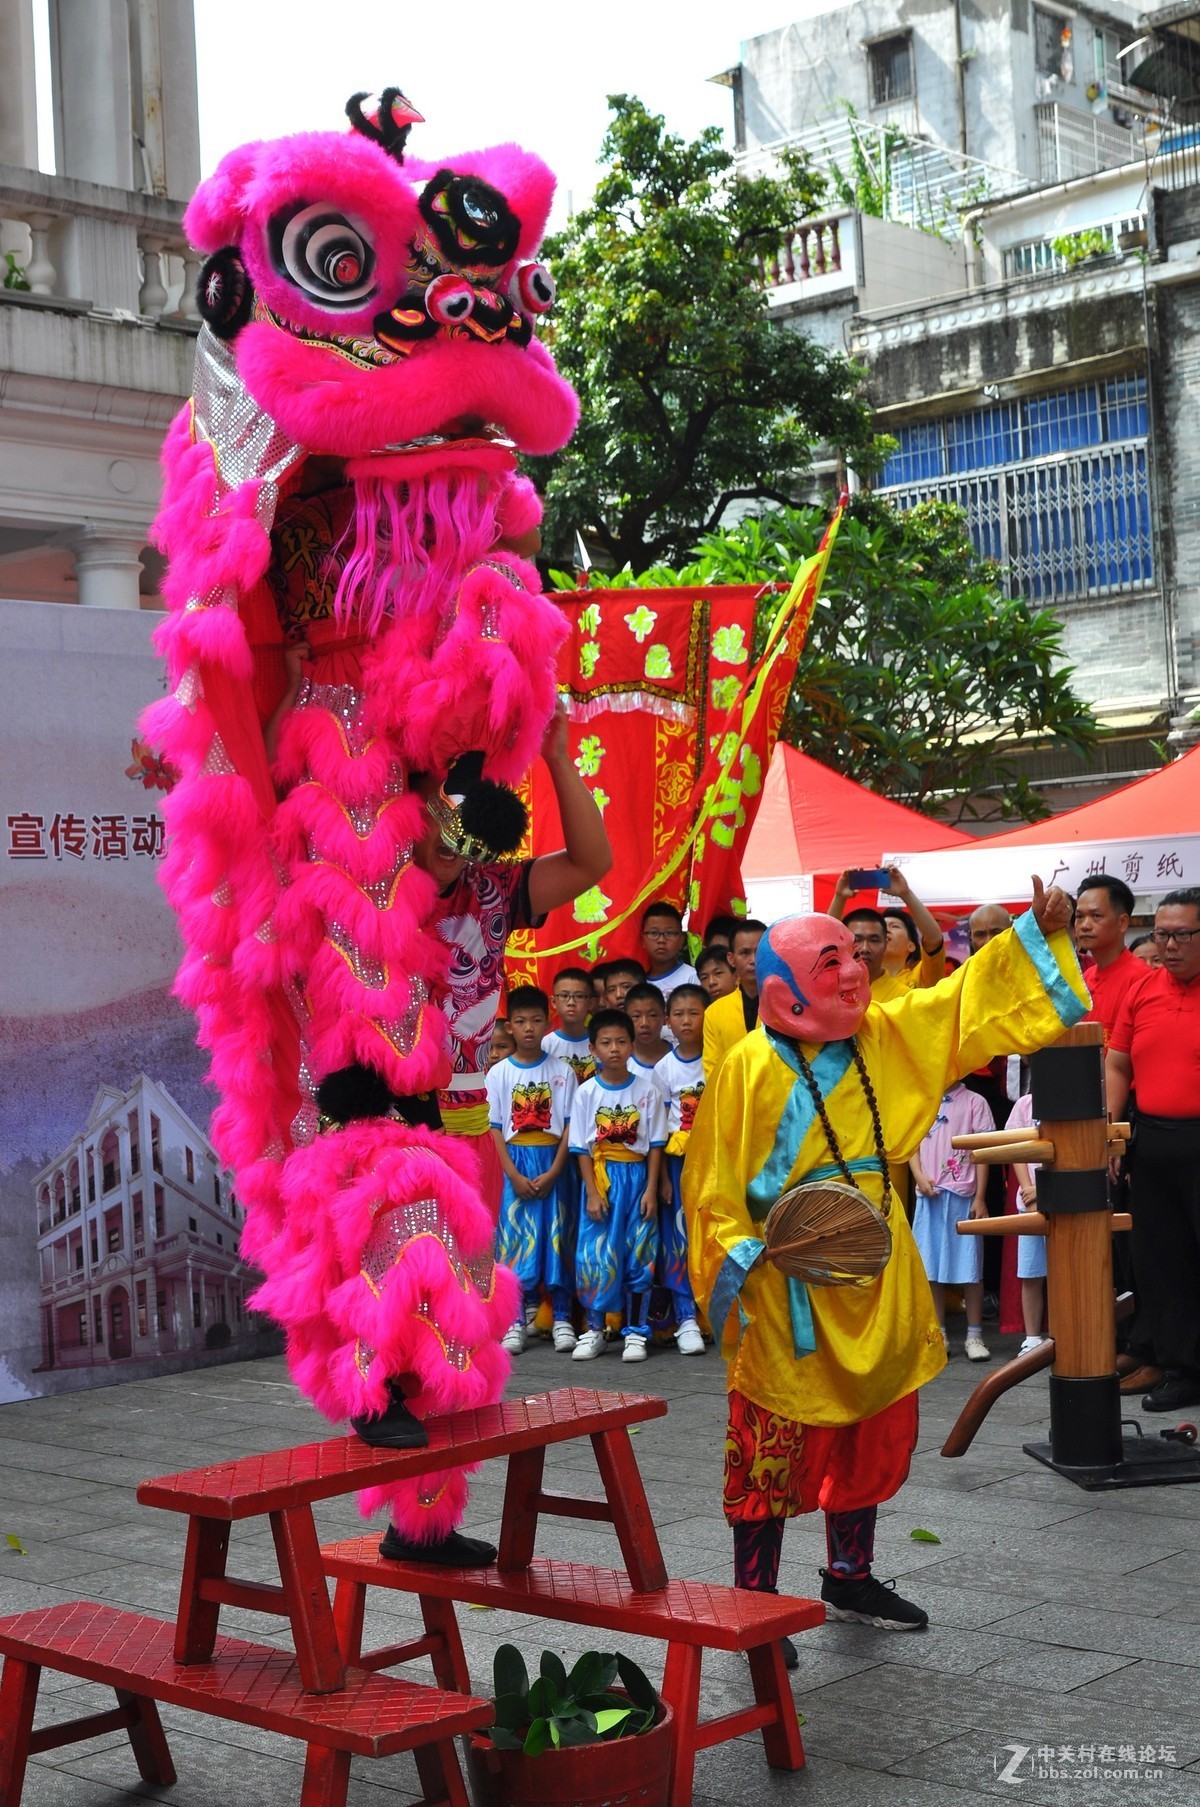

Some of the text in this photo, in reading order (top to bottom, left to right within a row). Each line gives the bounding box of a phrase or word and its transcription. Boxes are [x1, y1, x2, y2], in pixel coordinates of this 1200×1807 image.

[7, 812, 166, 859] 宣传活动
[1047, 851, 1184, 888] 广州剪纸
